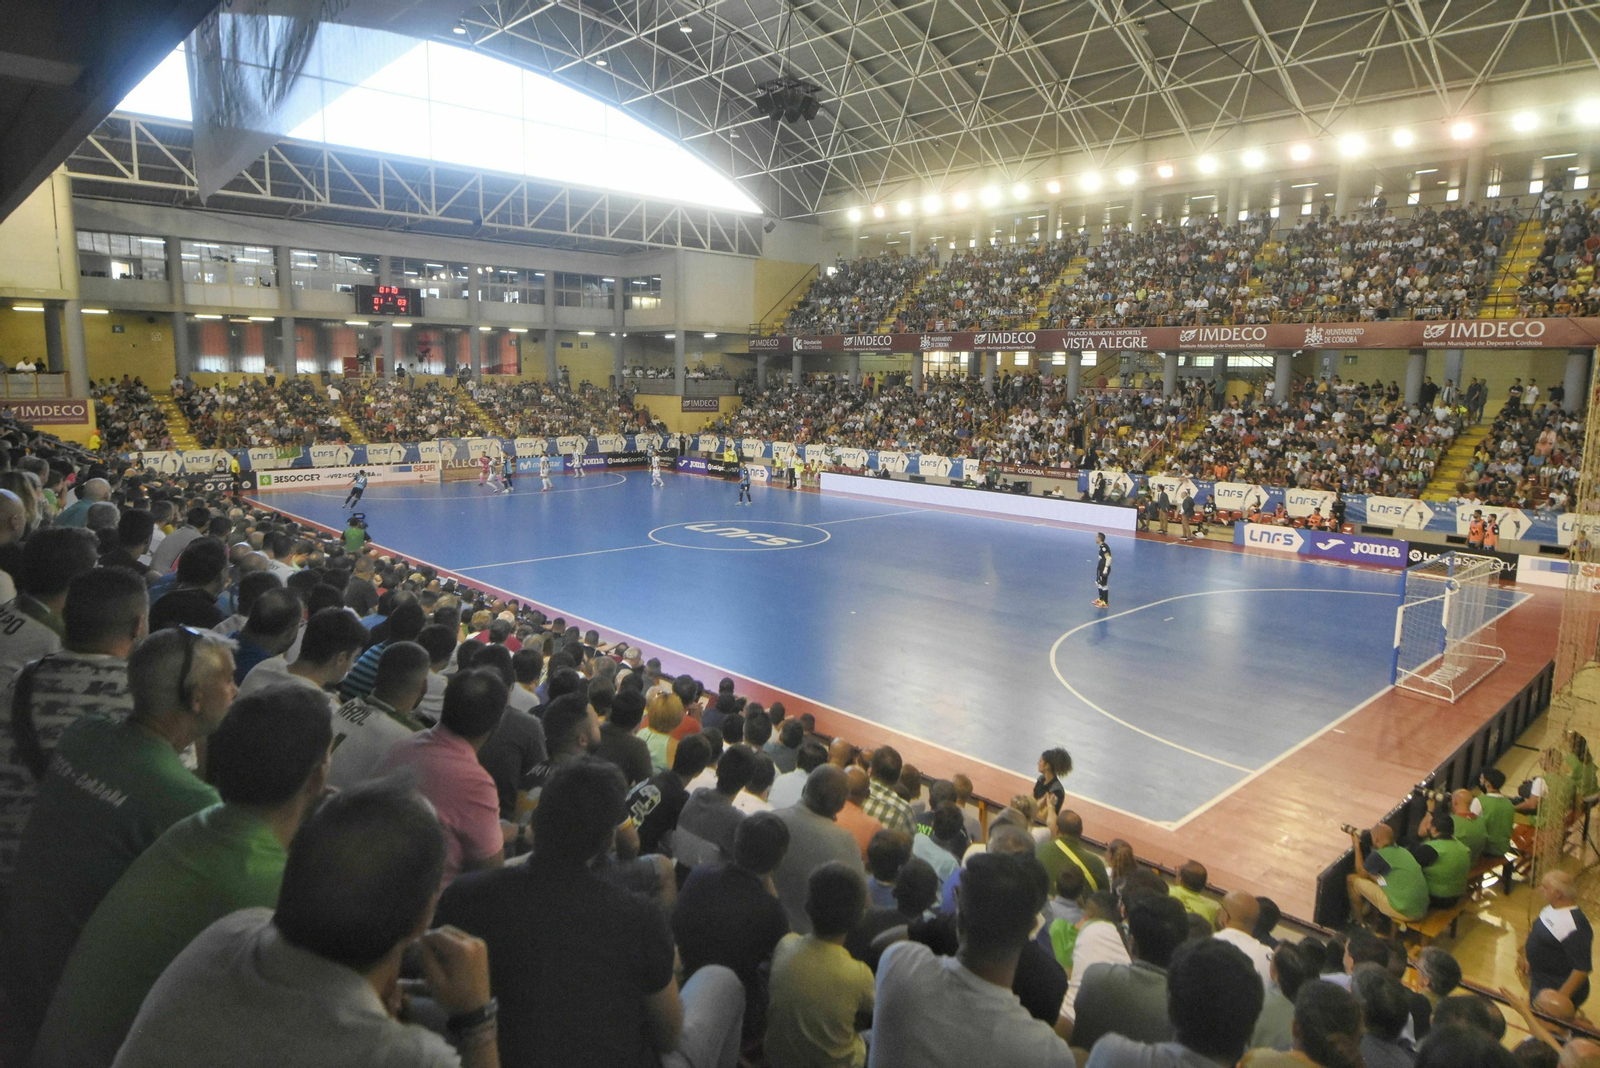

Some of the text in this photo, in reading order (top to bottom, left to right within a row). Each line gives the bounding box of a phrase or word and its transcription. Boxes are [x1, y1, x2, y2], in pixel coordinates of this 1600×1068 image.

[1200, 327, 1267, 341] IMDECO
[1324, 328, 1364, 336] AYUNTAMIENTO
[1450, 321, 1546, 338] IMDECO
[756, 339, 779, 347] IMDECO
[854, 336, 892, 346] IMDECO
[988, 332, 1036, 344] IMDECO
[1062, 336, 1148, 349] VISTA ALEGRE
[20, 405, 84, 417] IMDECO
[274, 474, 320, 482] BESOCCER
[750, 468, 764, 478] NFS
[1218, 488, 1243, 498] LNFS
[1289, 496, 1318, 506] LNFS
[1370, 504, 1402, 515] LNFS
[684, 524, 803, 546] LNFS
[1250, 529, 1294, 546] LNFS
[338, 701, 372, 726] RAUL
